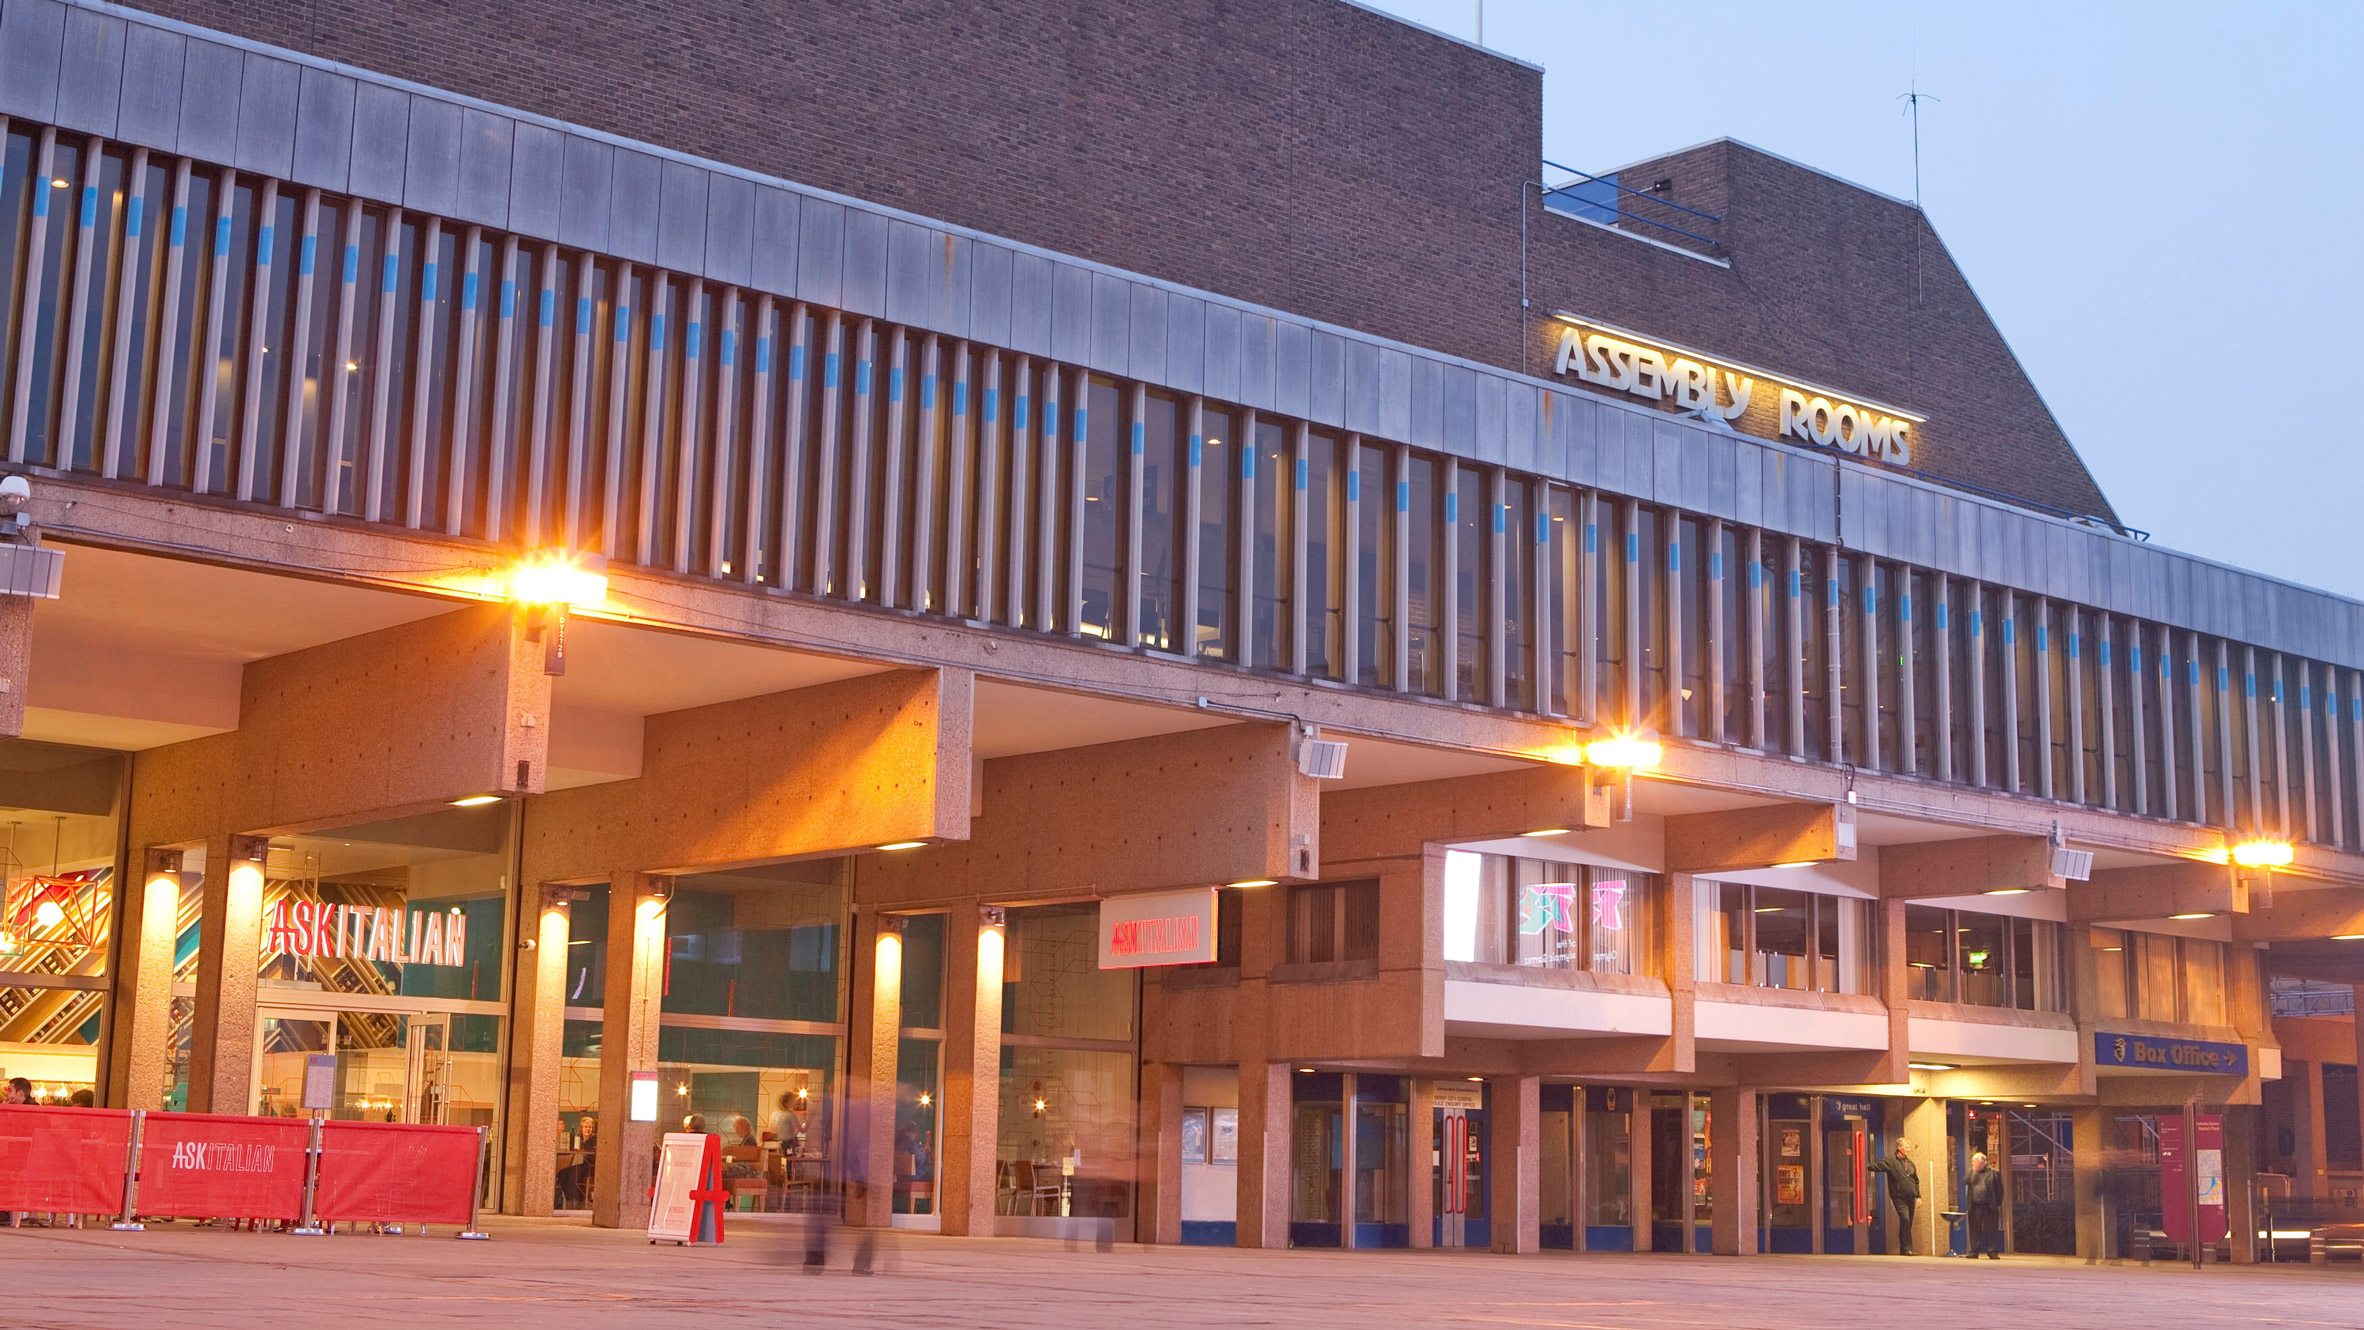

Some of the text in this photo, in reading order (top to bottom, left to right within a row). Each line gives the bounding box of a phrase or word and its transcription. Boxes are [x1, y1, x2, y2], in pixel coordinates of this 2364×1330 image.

[1555, 326, 1910, 466] ASSEMBLY ROOMS
[2134, 1041, 2219, 1067] Box Office
